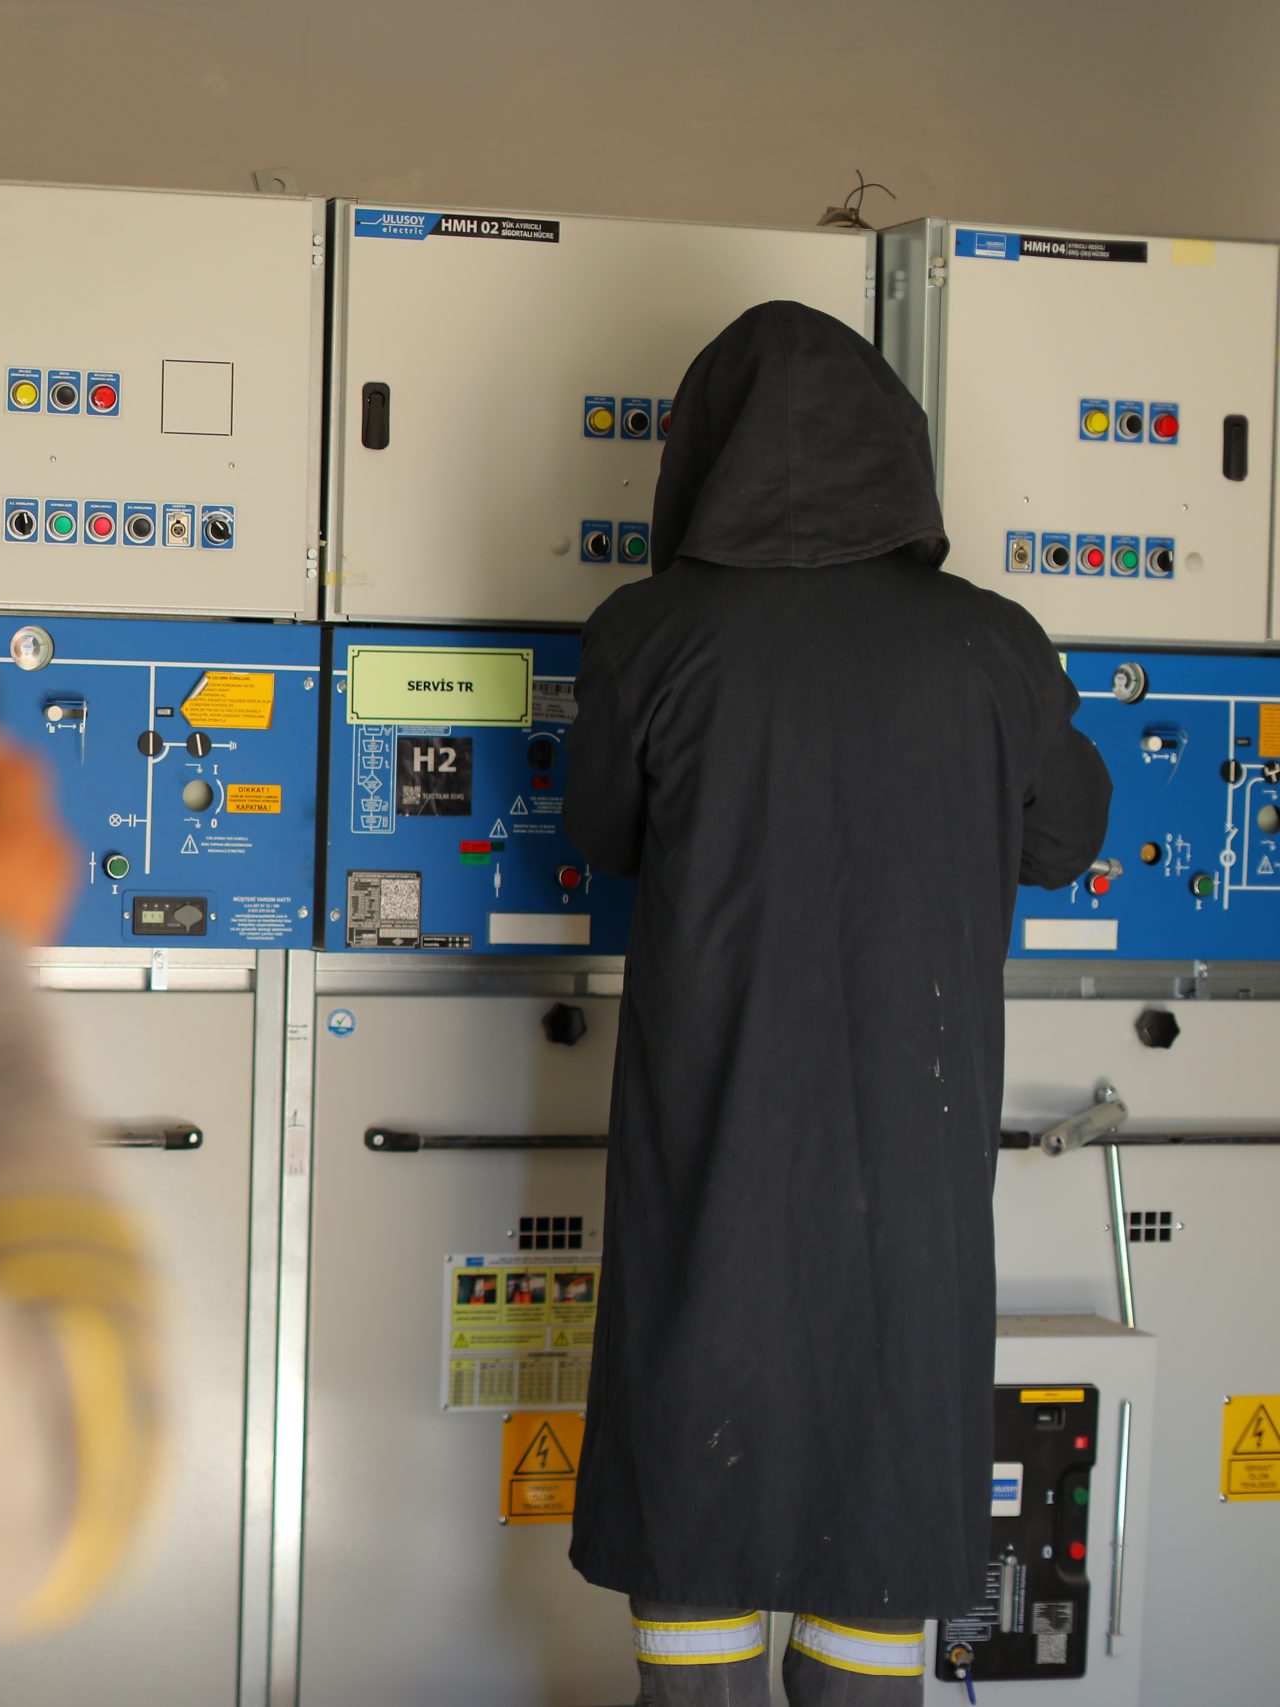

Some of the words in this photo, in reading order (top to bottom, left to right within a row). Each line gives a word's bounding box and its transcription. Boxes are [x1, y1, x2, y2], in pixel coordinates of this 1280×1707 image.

[382, 214, 425, 225] ULUSOY
[441, 218, 478, 234] HMH
[481, 221, 499, 235] 02
[382, 226, 424, 235] electric
[1023, 240, 1051, 254] HMH
[1052, 243, 1066, 254] 04
[407, 678, 454, 692] SERVİS
[457, 681, 474, 692] TR
[413, 747, 457, 773] H2
